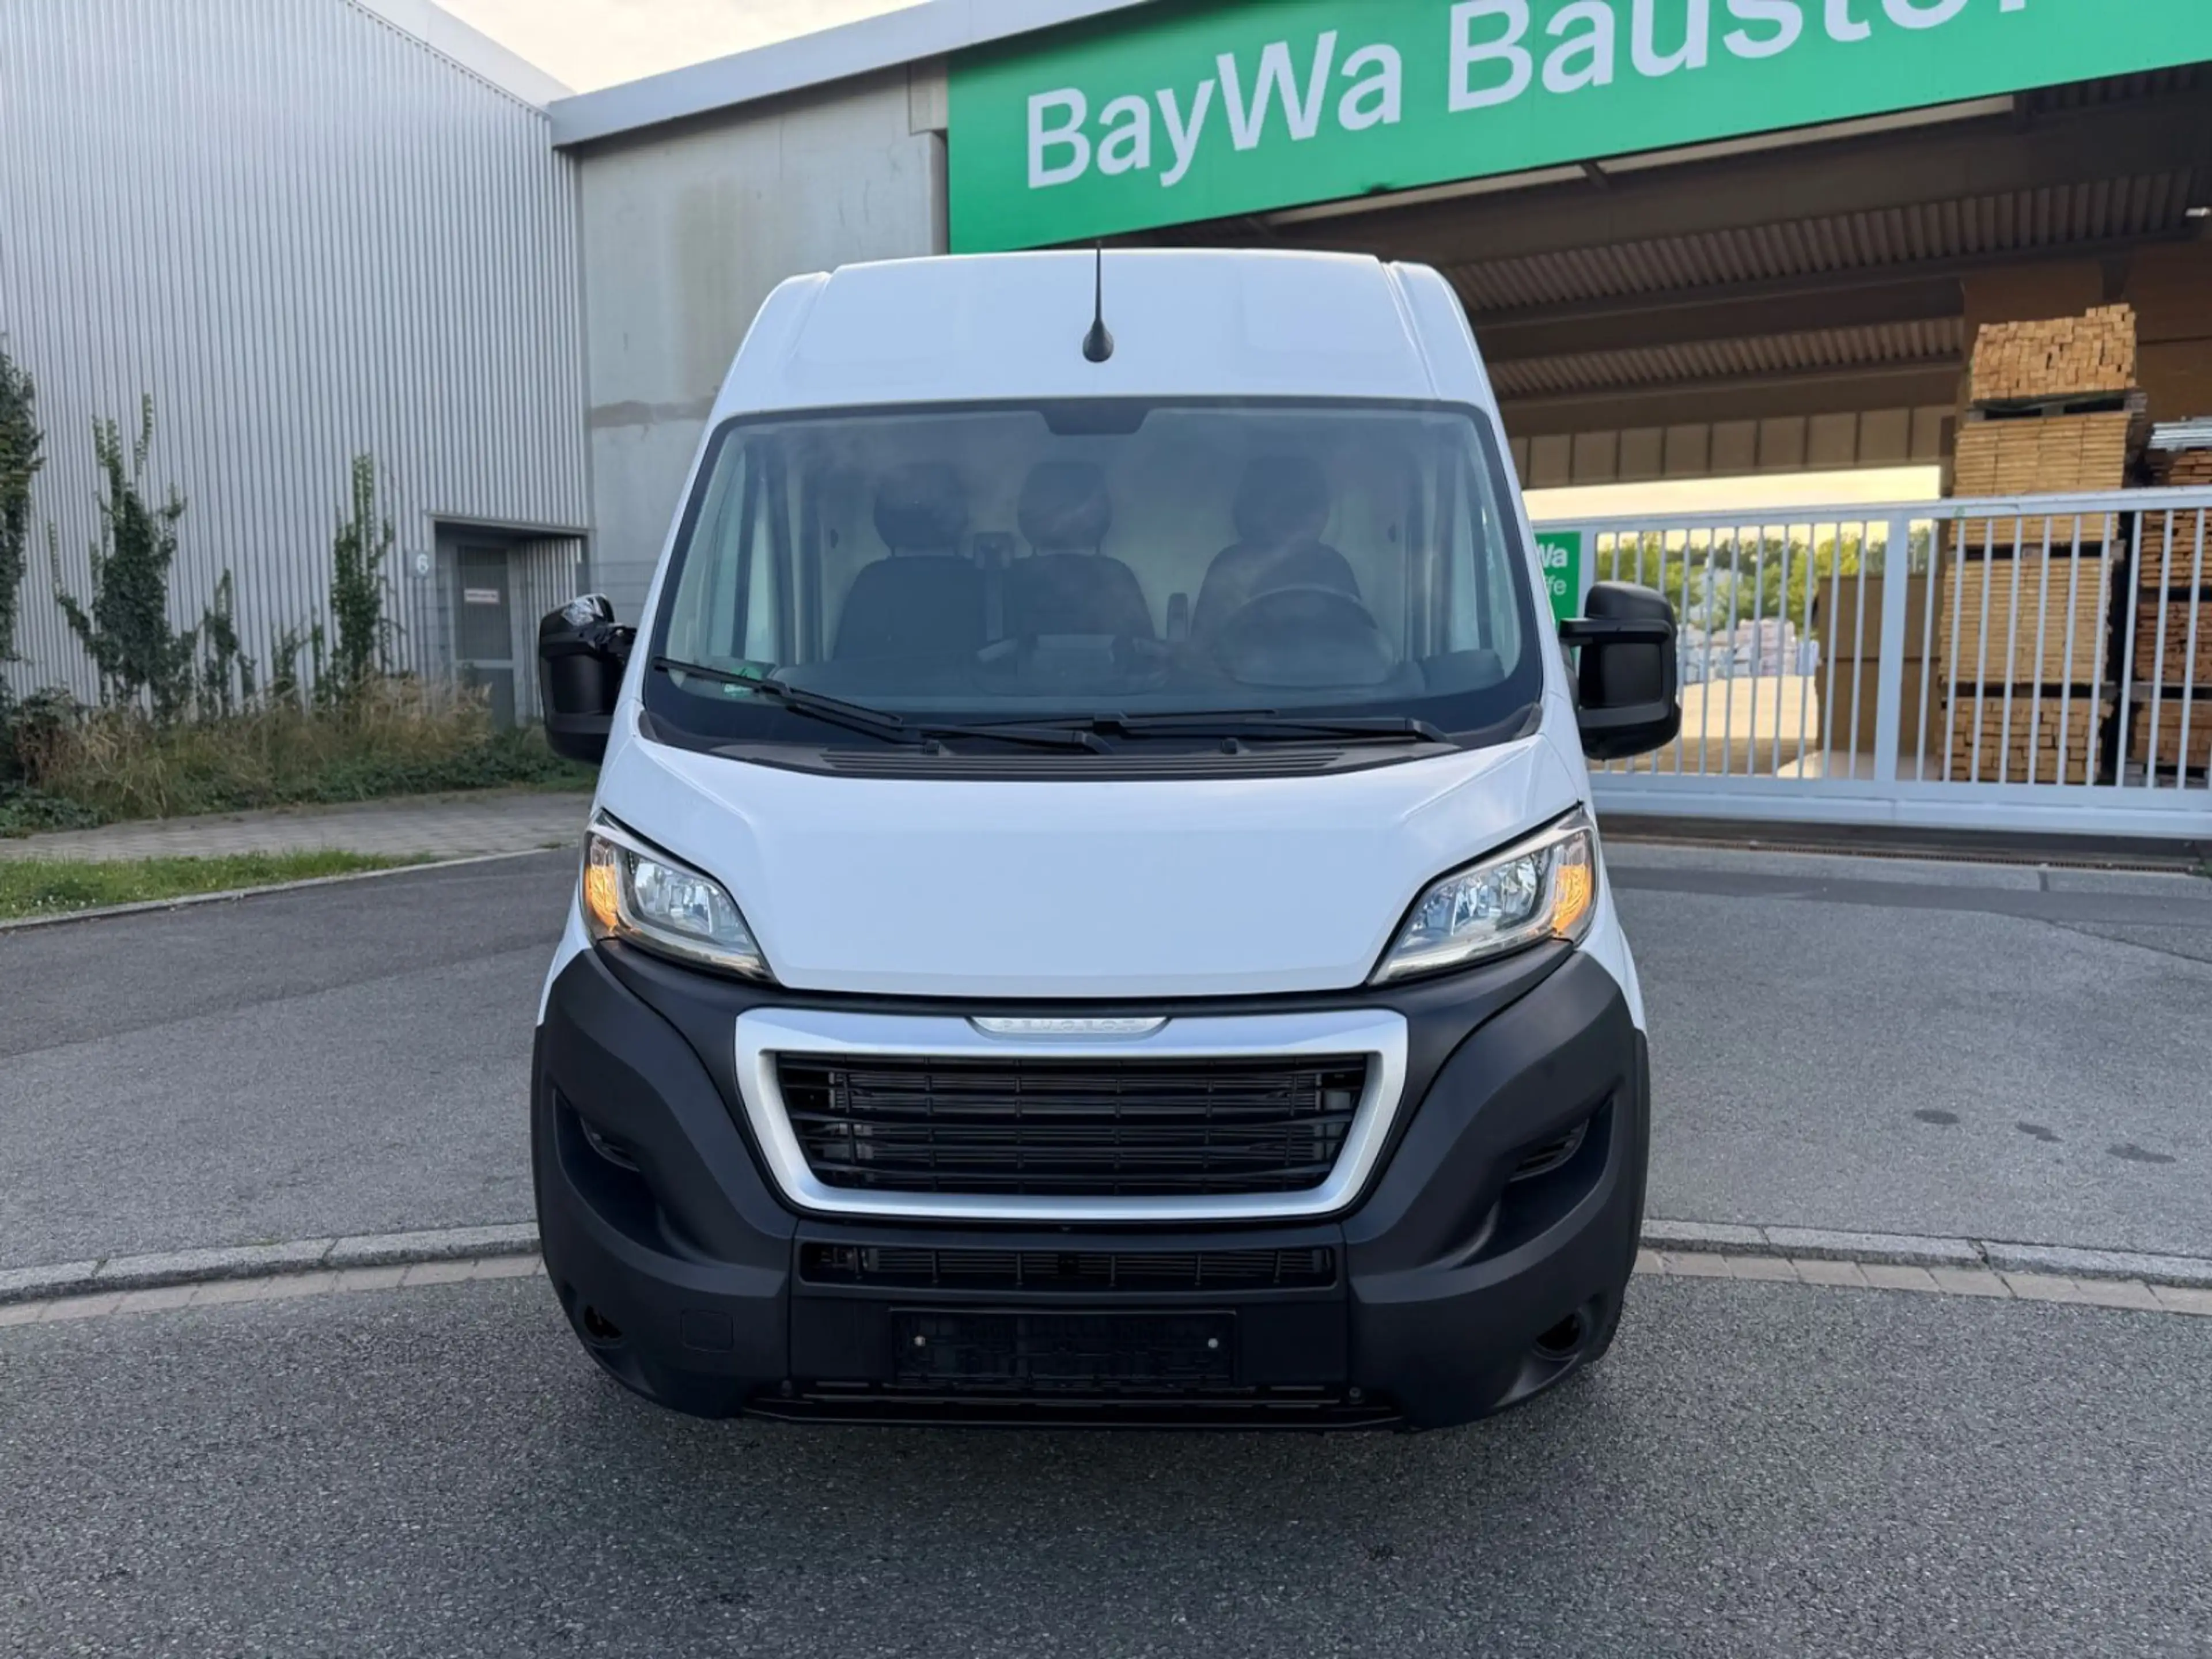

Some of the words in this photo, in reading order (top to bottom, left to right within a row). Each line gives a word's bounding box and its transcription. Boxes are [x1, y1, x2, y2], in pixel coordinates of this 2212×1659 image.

[1027, 30, 1402, 188] BayWa
[1448, 0, 2026, 112] Baus
[416, 553, 429, 575] 6
